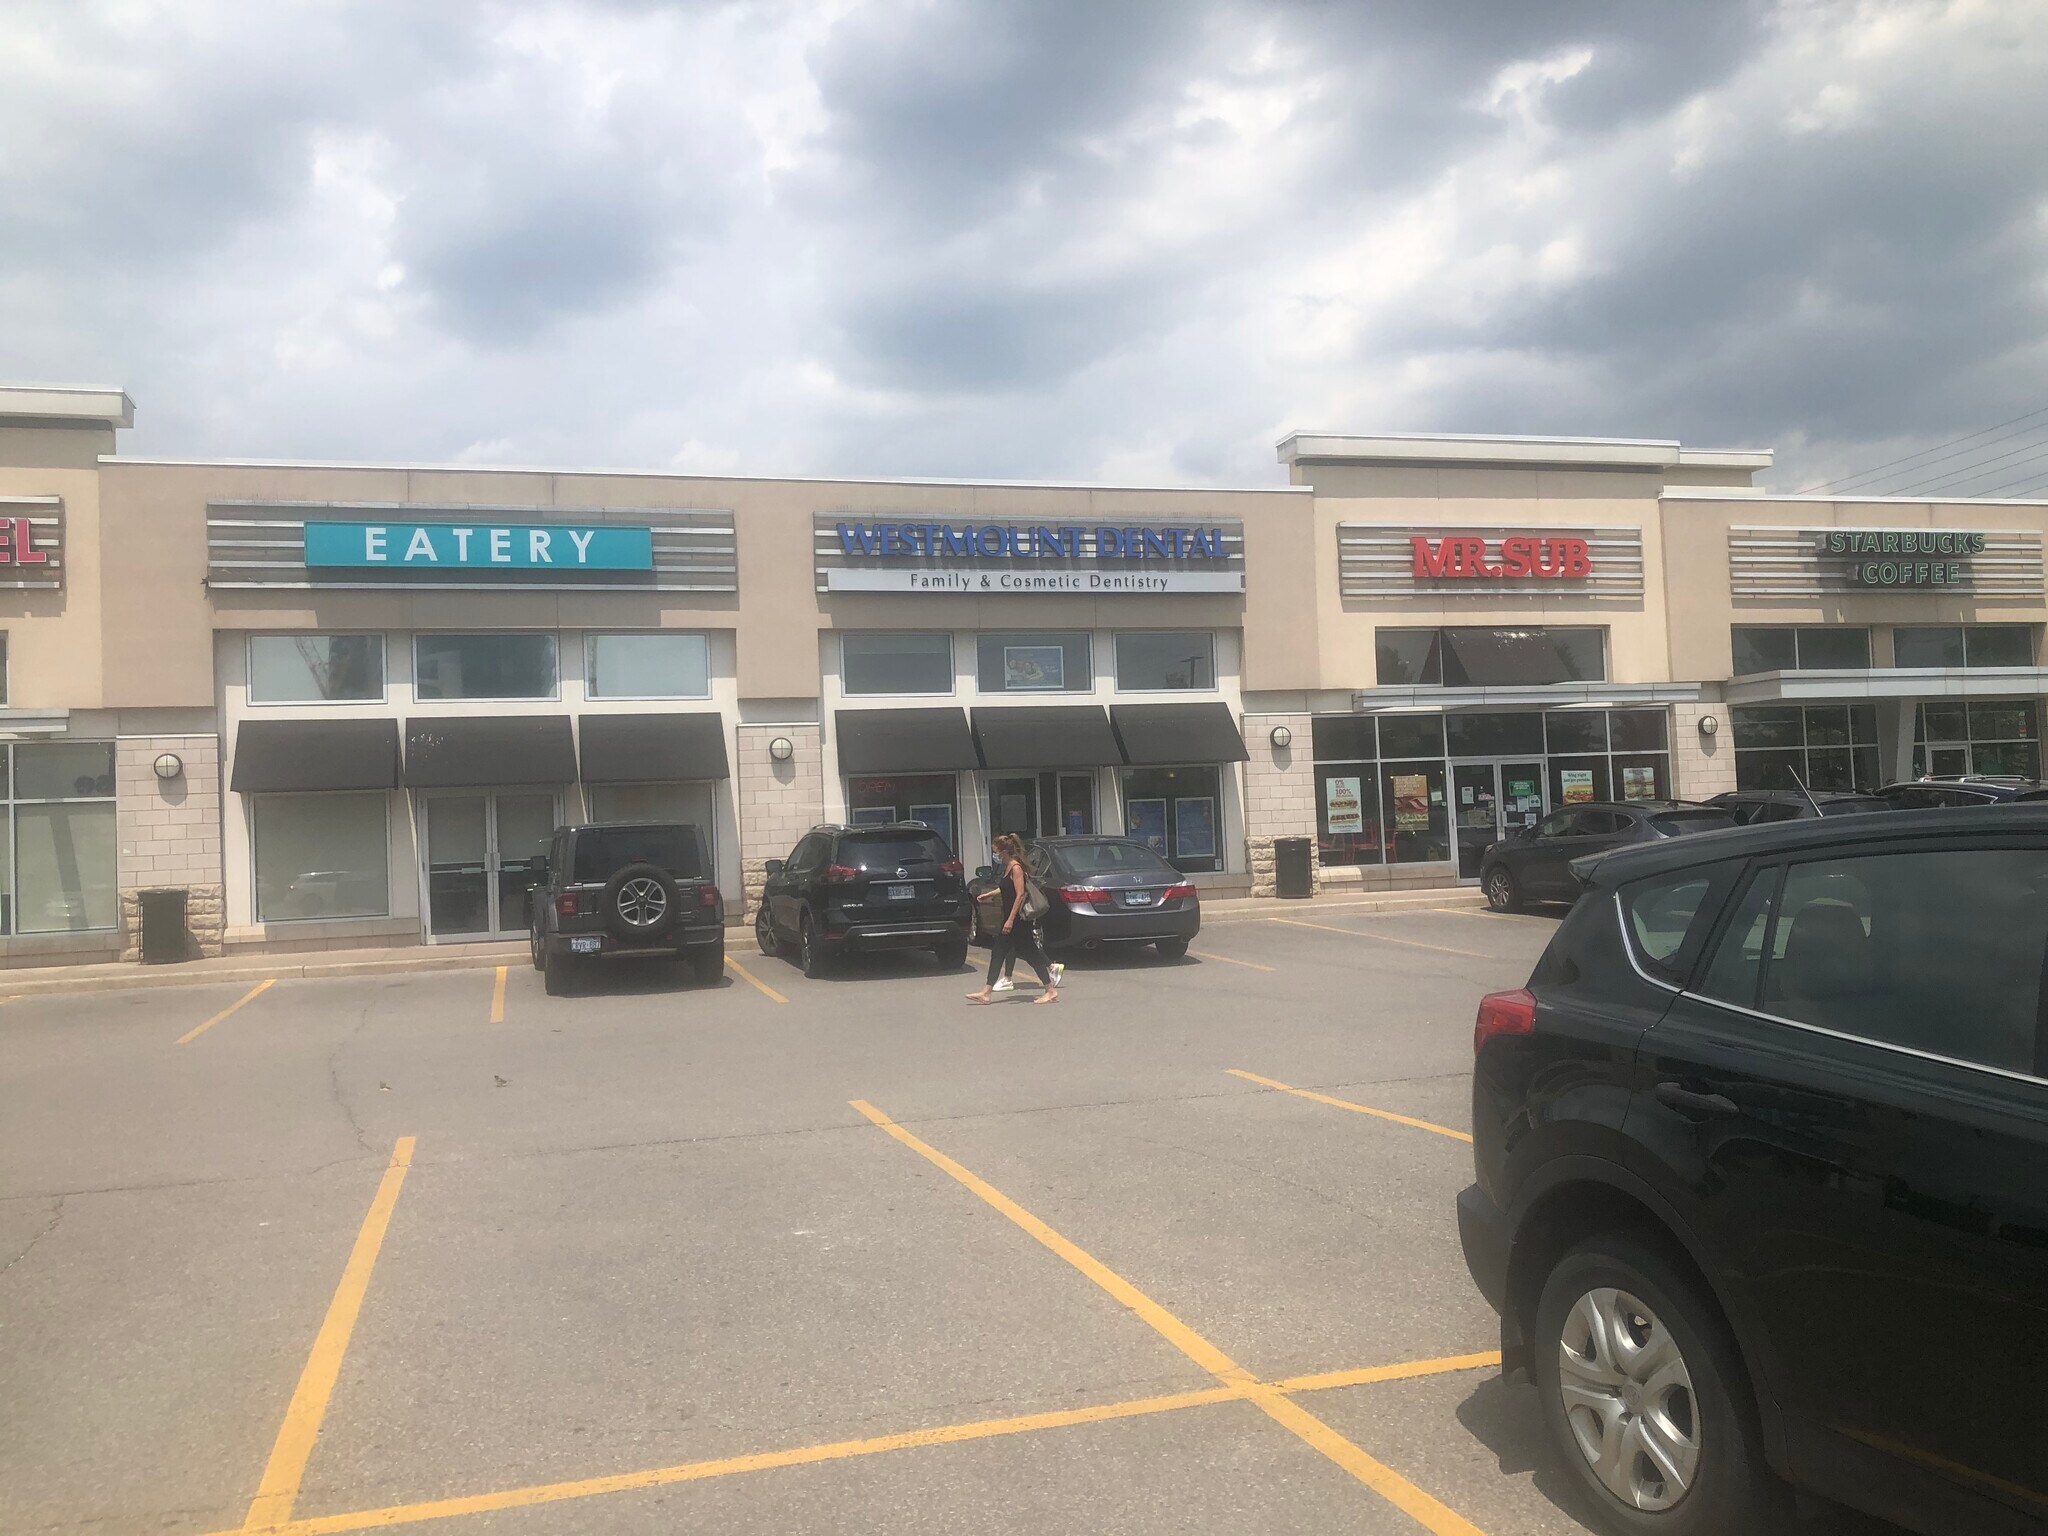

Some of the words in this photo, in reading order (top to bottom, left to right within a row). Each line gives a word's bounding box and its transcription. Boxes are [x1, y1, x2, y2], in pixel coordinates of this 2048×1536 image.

[365, 527, 595, 563] EATERY
[836, 522, 1085, 558] WESTMOUNT
[1095, 526, 1230, 560] DENTAL
[1830, 531, 1986, 553] STARBUCKS
[910, 573, 970, 591] Family
[980, 574, 991, 588] &
[1000, 574, 1080, 589] Cosmetic
[1090, 575, 1169, 591] Dentistry
[1862, 562, 1960, 584] COFFEE
